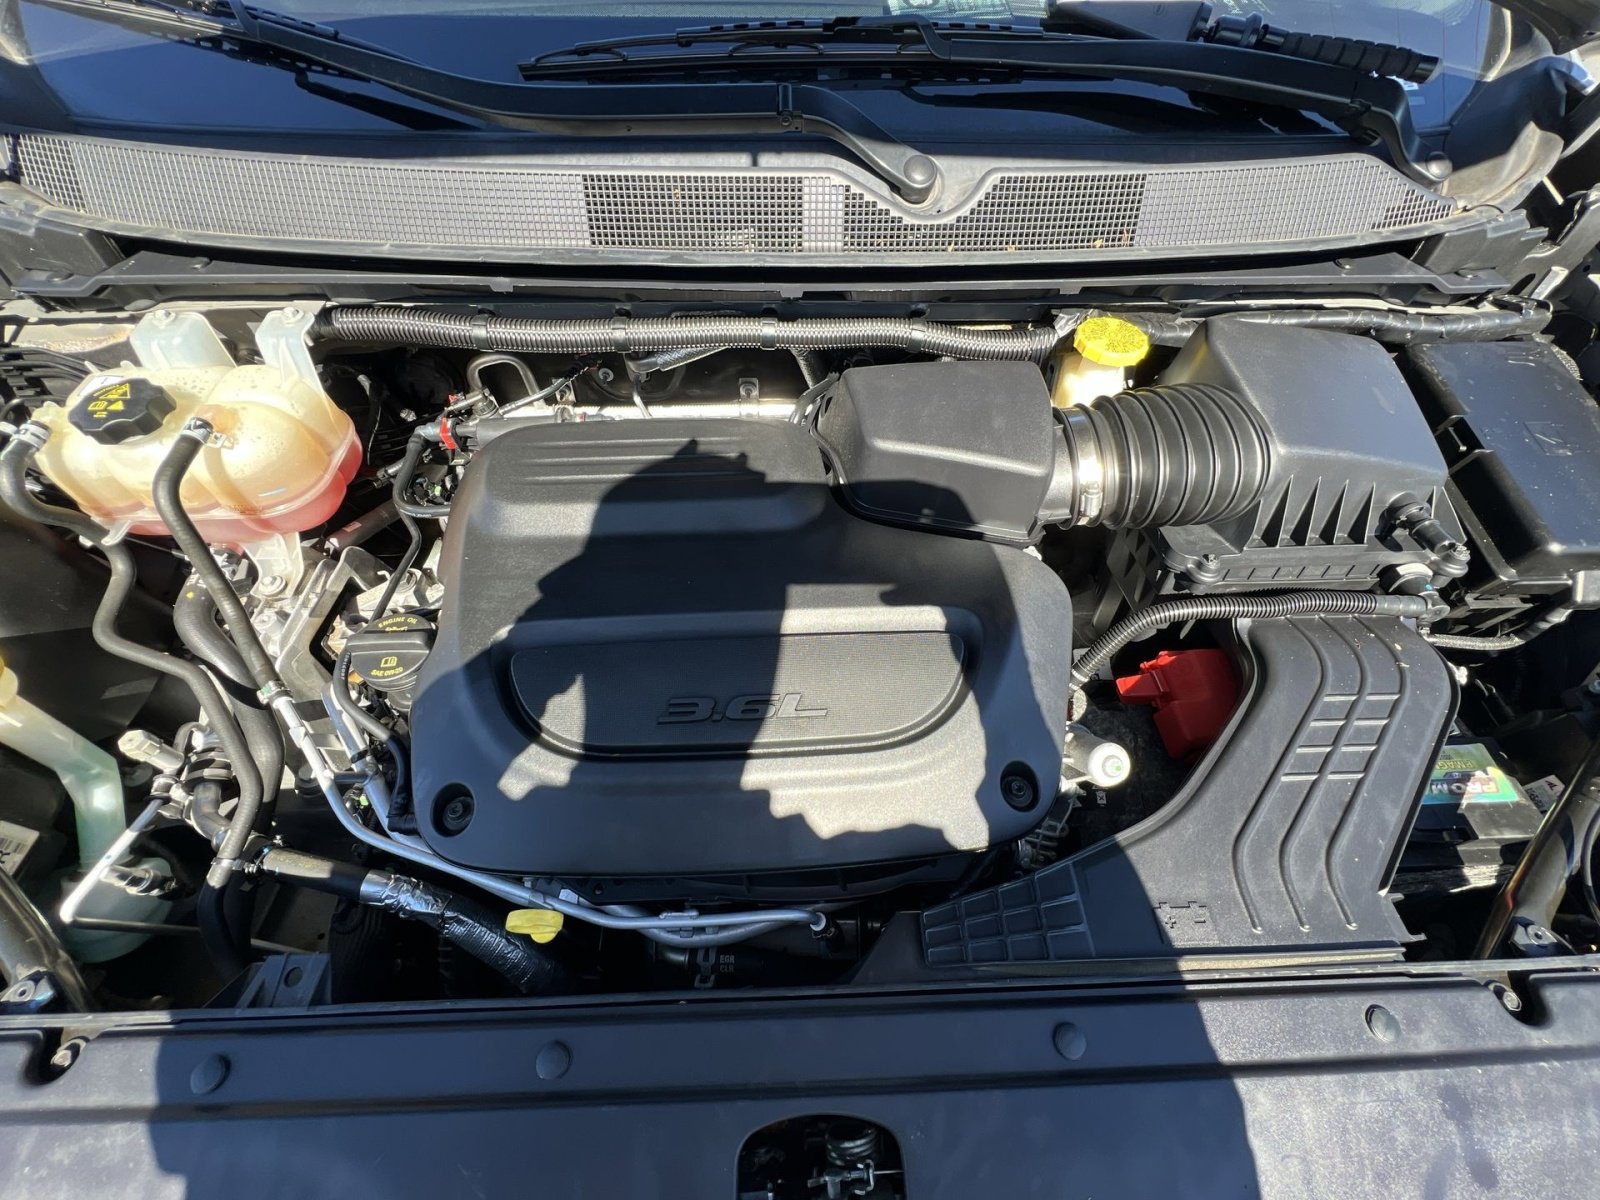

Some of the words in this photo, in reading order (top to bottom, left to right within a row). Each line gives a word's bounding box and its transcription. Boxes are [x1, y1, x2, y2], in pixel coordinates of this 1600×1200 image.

[378, 616, 406, 628] ENGINE
[406, 616, 418, 625] OIL
[656, 692, 828, 725] 3.6L
[719, 954, 735, 964] EGR
